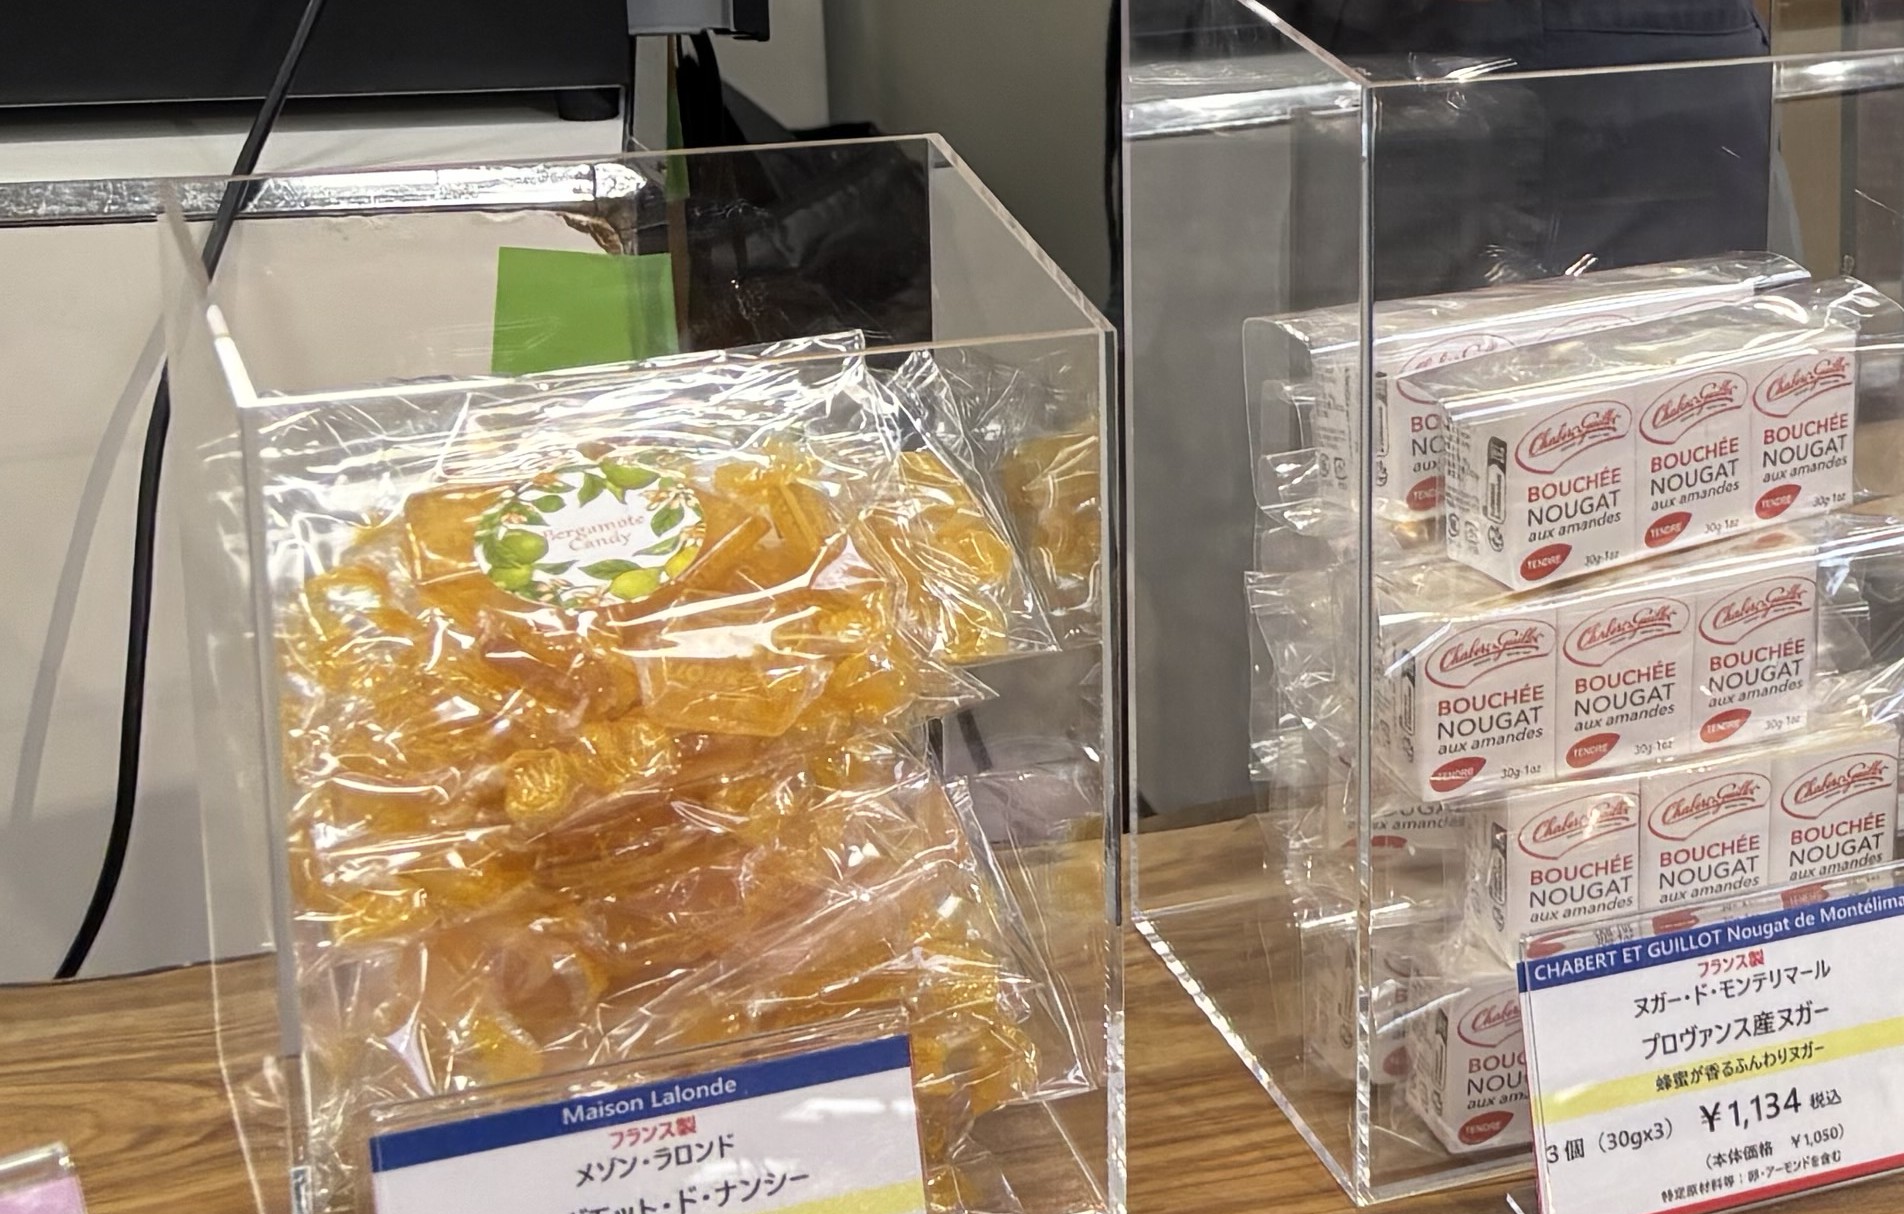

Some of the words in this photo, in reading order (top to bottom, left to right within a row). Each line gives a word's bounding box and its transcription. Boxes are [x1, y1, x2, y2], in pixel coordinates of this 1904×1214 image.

[1764, 413, 1848, 445] BOUCHÉE
[1651, 438, 1739, 473] BOUCHÉE
[1762, 435, 1848, 468] NOUGAT
[1528, 468, 1621, 502] BOUCHÉE
[1650, 459, 1739, 496] NOUGAT
[1527, 490, 1620, 527] NOUGAT
[568, 532, 631, 551] Candy
[1528, 528, 1555, 542] aux
[1558, 511, 1621, 536] amandes
[1710, 638, 1806, 672] BOUCHÉE
[1575, 662, 1676, 695] BOUCHÉE
[1708, 659, 1803, 693] NOUGAT
[1437, 684, 1544, 716] BOUCHÉE
[1574, 683, 1676, 717] NOUGAT
[1437, 706, 1543, 740] NOUGAT
[1574, 718, 1602, 732] aux
[1606, 703, 1675, 727] amandes
[1438, 740, 1467, 755] aux
[1470, 726, 1543, 751] amandes
[1791, 813, 1885, 846] BOUCHÉE
[1660, 835, 1760, 868] BOUCHÉE
[1789, 833, 1884, 867] NOUGAT
[1530, 854, 1633, 887] BOUCHÉE
[1659, 855, 1759, 889] NOUGAT
[1530, 876, 1633, 908] NOUGAT
[1530, 910, 1559, 924] aux
[1562, 895, 1633, 919] amandes
[1534, 952, 1617, 981] CHABERT
[1622, 944, 1641, 962] ET
[1647, 930, 1723, 958] GUILLOT
[1727, 918, 1790, 947] Nougat
[1795, 911, 1816, 928] de
[1698, 951, 1765, 978] フランス製
[1634, 961, 1831, 1018] ヌガー・ド・モンテリマール
[1641, 1005, 1829, 1060] プロヴァンス産ヌガー
[1655, 1044, 1825, 1091] 蜂蜜が香るふんわりヌガー
[562, 1092, 645, 1125] Maison
[650, 1077, 737, 1107] Lalonde
[1700, 1089, 1802, 1133] ¥1,134
[1810, 1090, 1842, 1109] 税込
[610, 1117, 696, 1149] フランス製
[576, 1135, 734, 1187] メゾン・ラロンド
